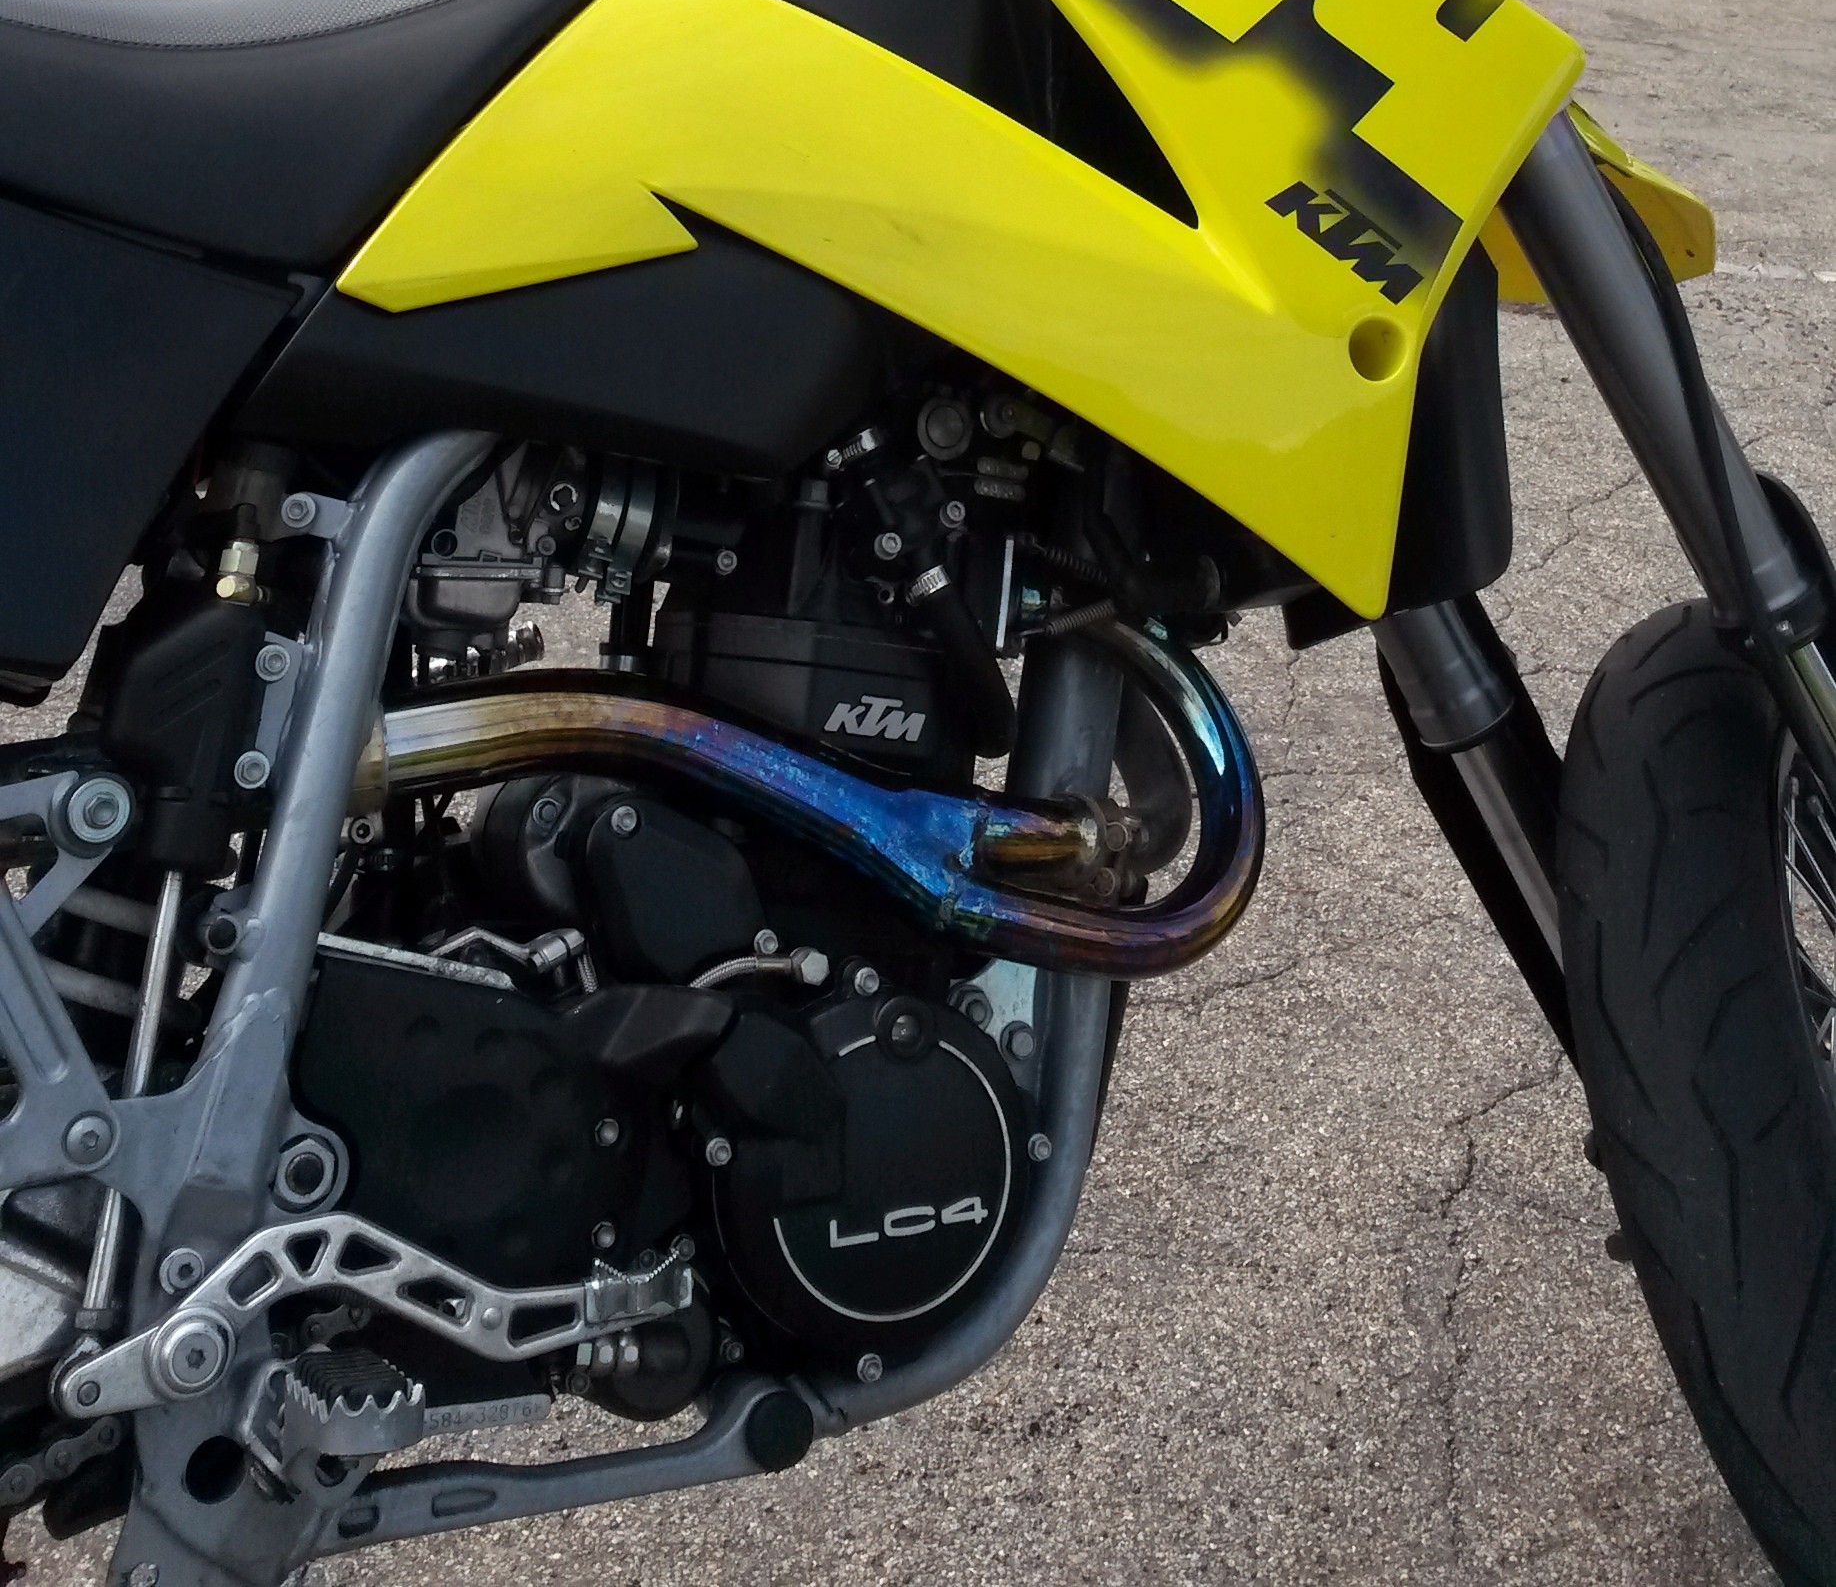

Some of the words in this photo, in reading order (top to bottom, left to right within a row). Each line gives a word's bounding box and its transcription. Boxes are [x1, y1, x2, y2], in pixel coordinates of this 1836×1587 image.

[1264, 181, 1424, 305] KTM
[824, 695, 926, 742] KTM
[829, 1196, 988, 1248] LC4
